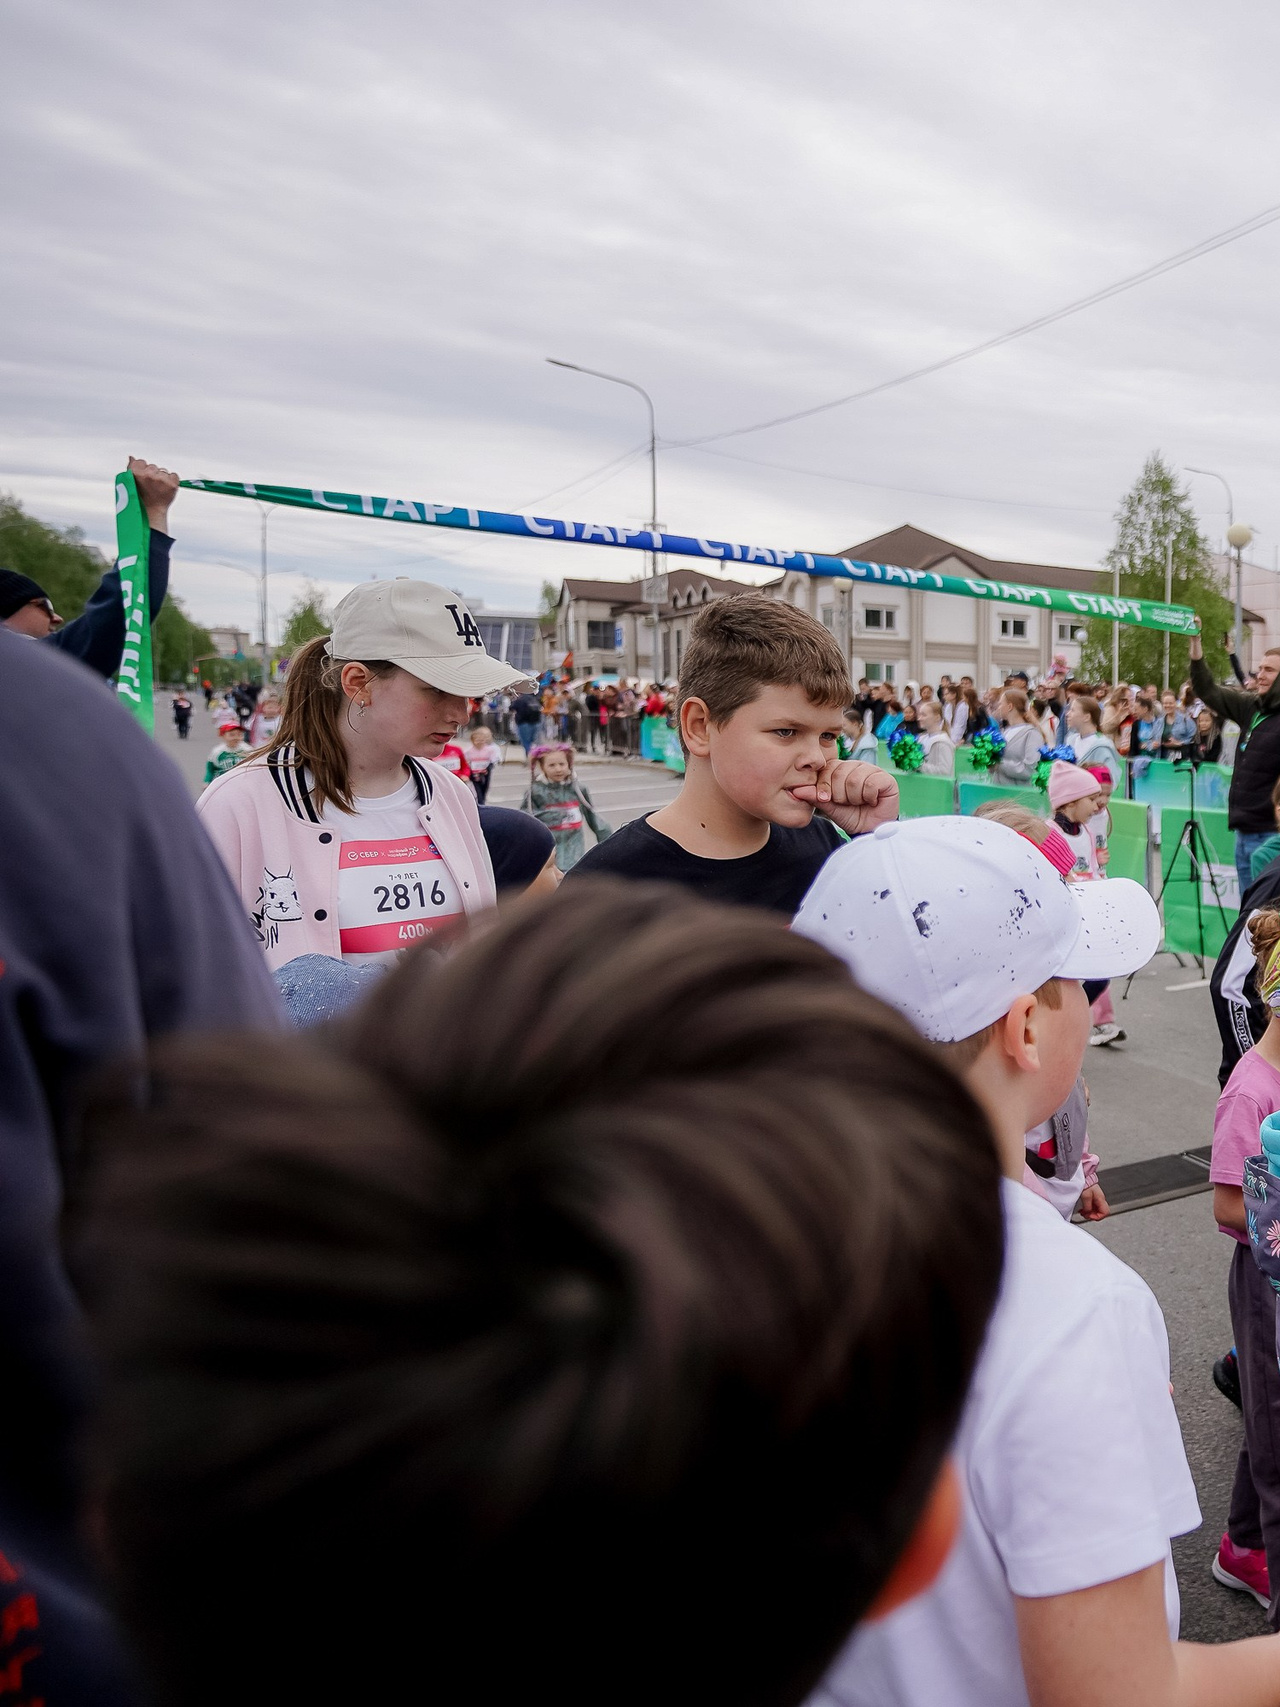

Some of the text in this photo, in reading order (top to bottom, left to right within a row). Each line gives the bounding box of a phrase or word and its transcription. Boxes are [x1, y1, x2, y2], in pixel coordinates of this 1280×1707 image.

[964, 578, 1053, 606] СТАРТ
[1066, 592, 1143, 622] СТАРТ
[444, 603, 483, 647] LA
[404, 872, 419, 880] ЛЕТ
[373, 879, 446, 913] 2816
[1235, 1011, 1252, 1050] Kappa
